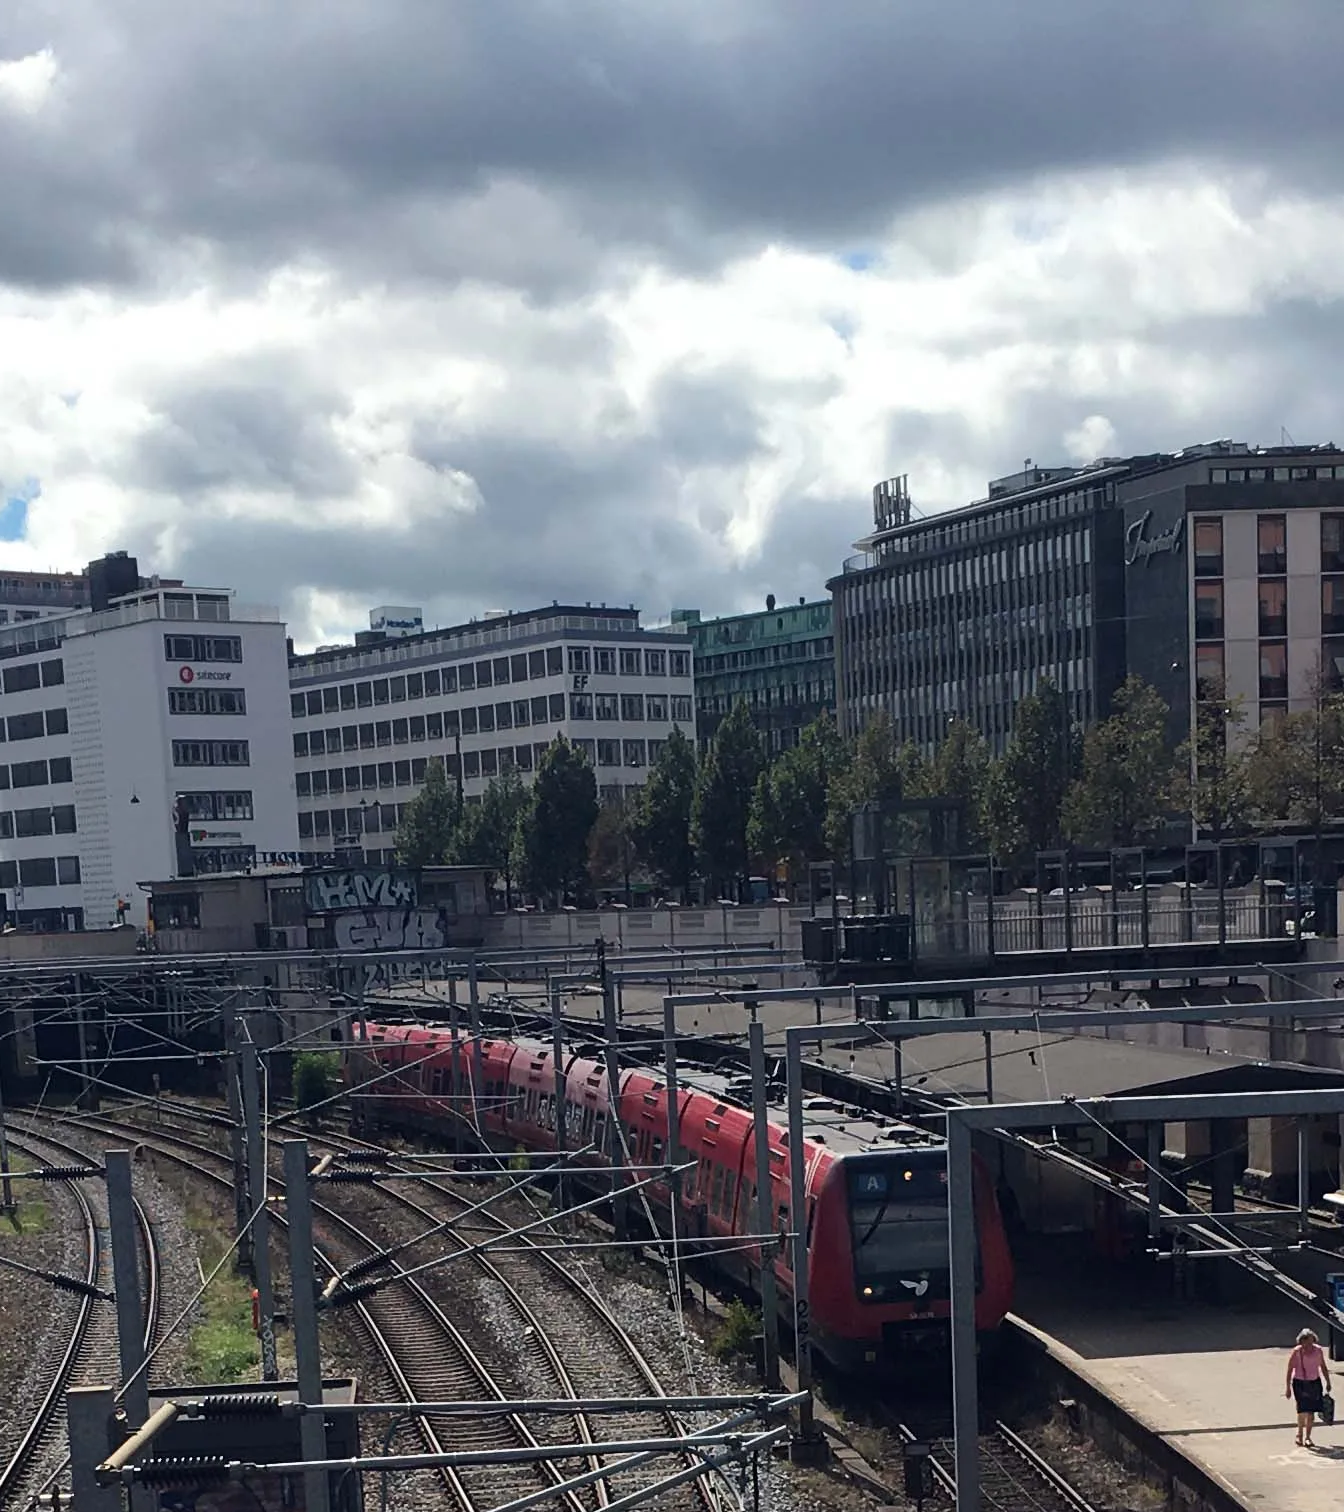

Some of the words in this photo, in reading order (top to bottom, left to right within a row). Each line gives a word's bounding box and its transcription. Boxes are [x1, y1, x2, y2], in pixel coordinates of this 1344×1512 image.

[196, 670, 232, 681] sitecore
[573, 675, 588, 689] EF
[866, 1175, 879, 1190] A
